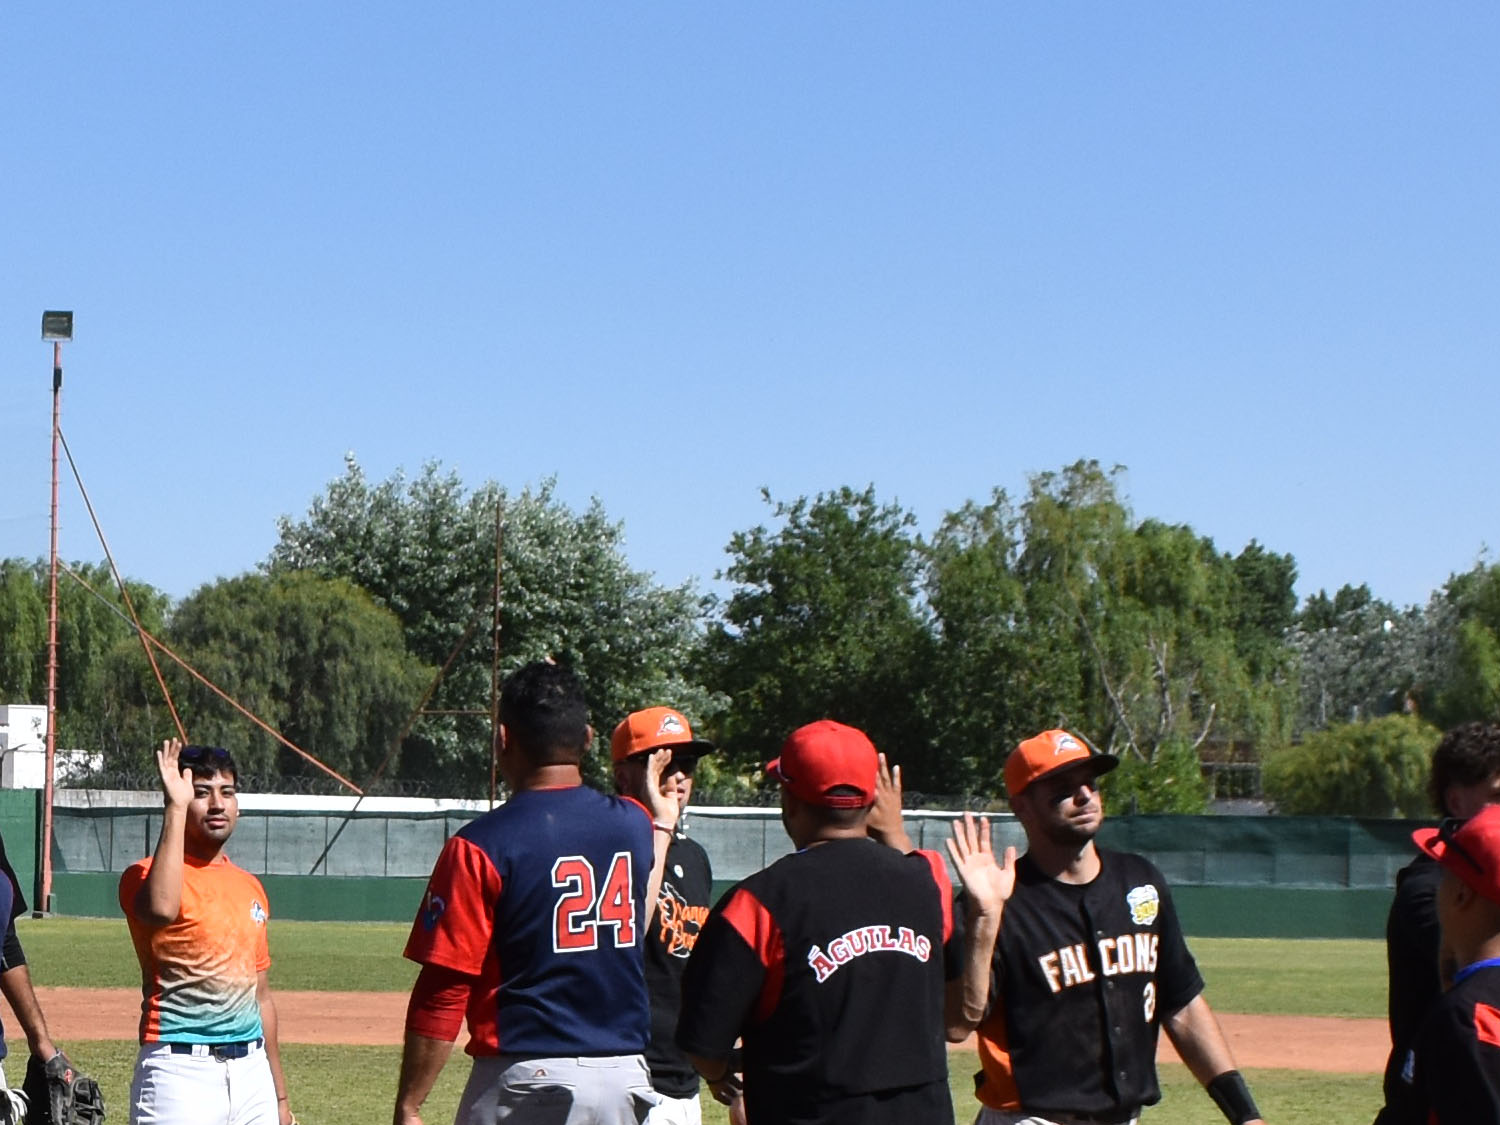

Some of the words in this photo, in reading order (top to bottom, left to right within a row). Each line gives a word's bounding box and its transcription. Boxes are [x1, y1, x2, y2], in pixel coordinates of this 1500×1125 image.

[551, 851, 636, 954] 24
[807, 924, 932, 984] ÁGUILAS
[1038, 932, 1160, 994] FALCONS
